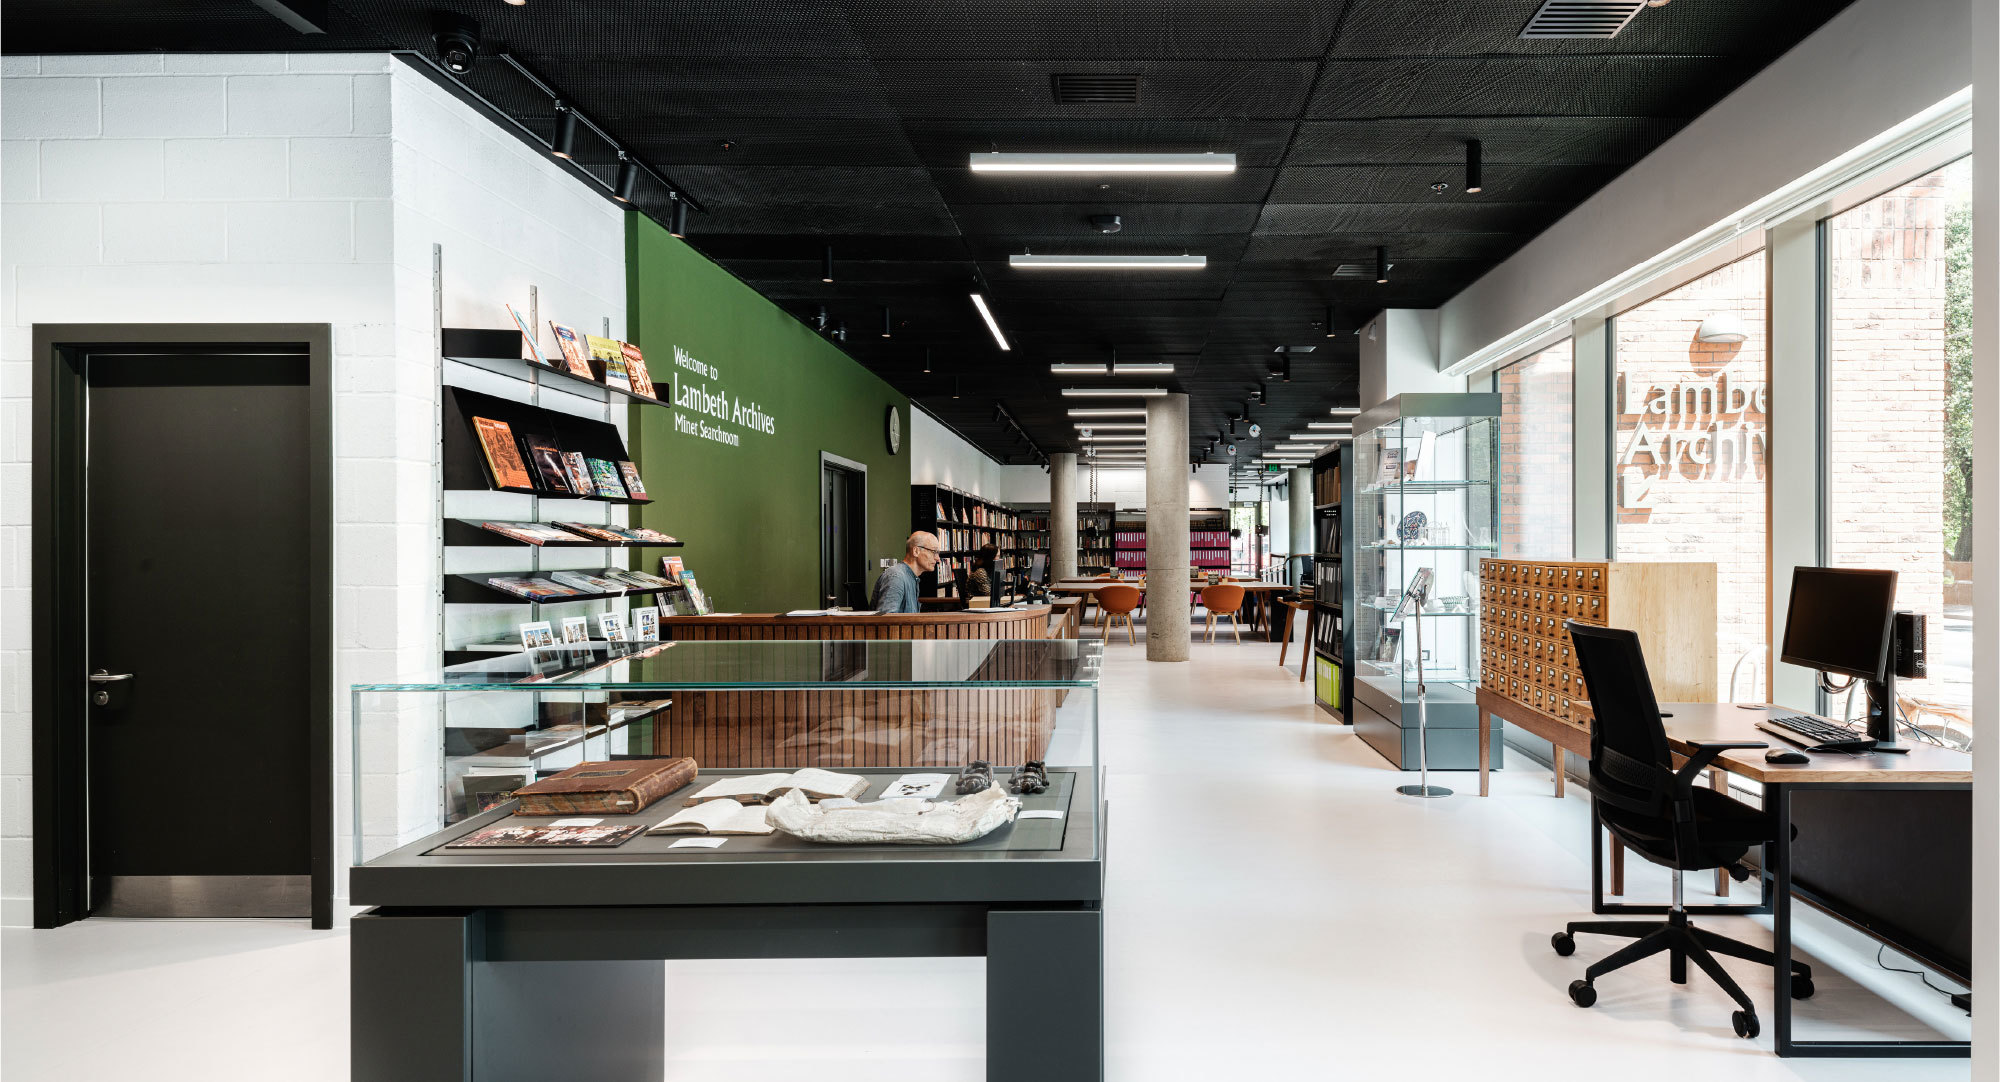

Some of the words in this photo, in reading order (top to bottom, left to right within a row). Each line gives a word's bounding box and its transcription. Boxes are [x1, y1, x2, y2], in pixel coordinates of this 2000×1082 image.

[673, 344, 708, 377] Welcome
[710, 364, 718, 381] to
[673, 371, 729, 421] Lambeth
[731, 395, 775, 435] Archives
[674, 411, 699, 437] Minet
[699, 419, 739, 447] Searchroom
